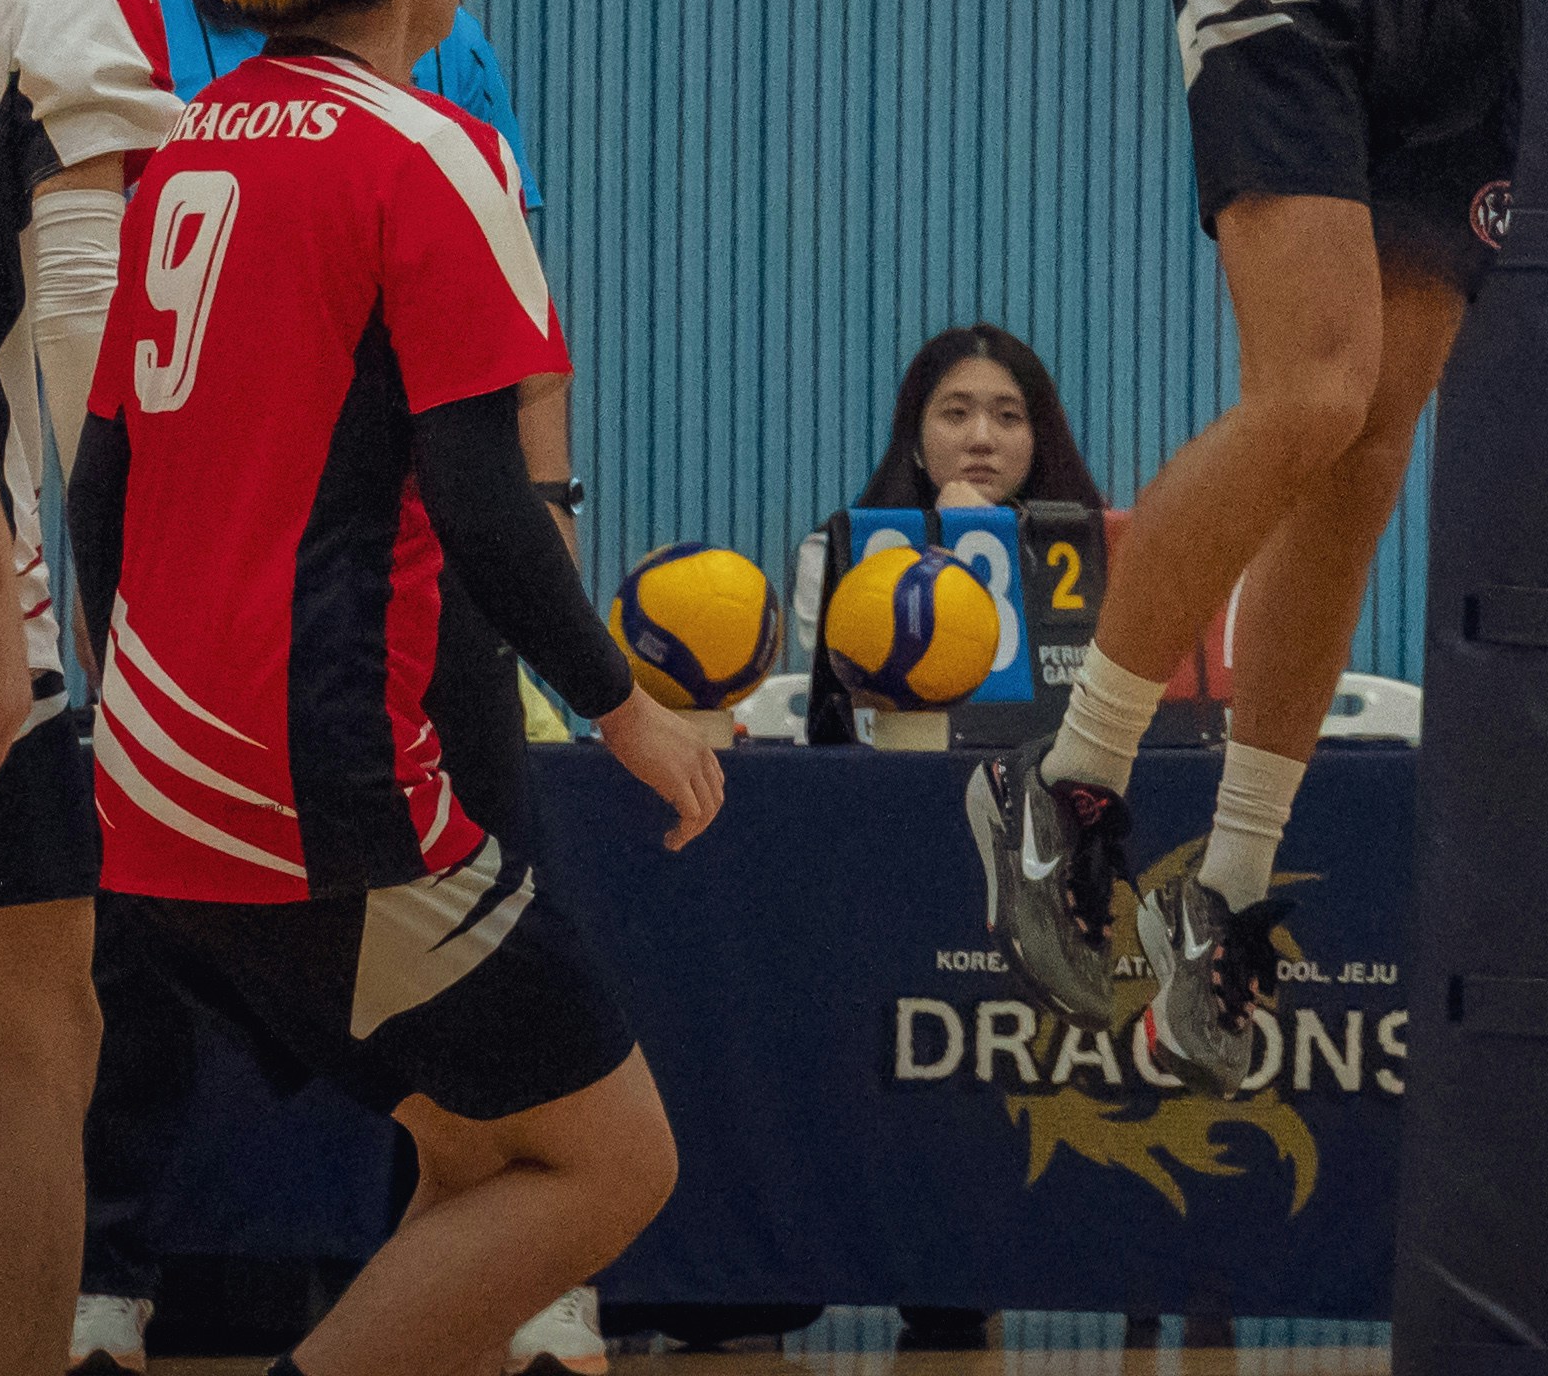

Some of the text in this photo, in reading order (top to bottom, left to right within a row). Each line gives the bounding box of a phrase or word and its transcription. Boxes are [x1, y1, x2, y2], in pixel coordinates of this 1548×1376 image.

[133, 170, 241, 413] 9
[1046, 540, 1085, 610] 2
[1336, 961, 1398, 986] JEJU
